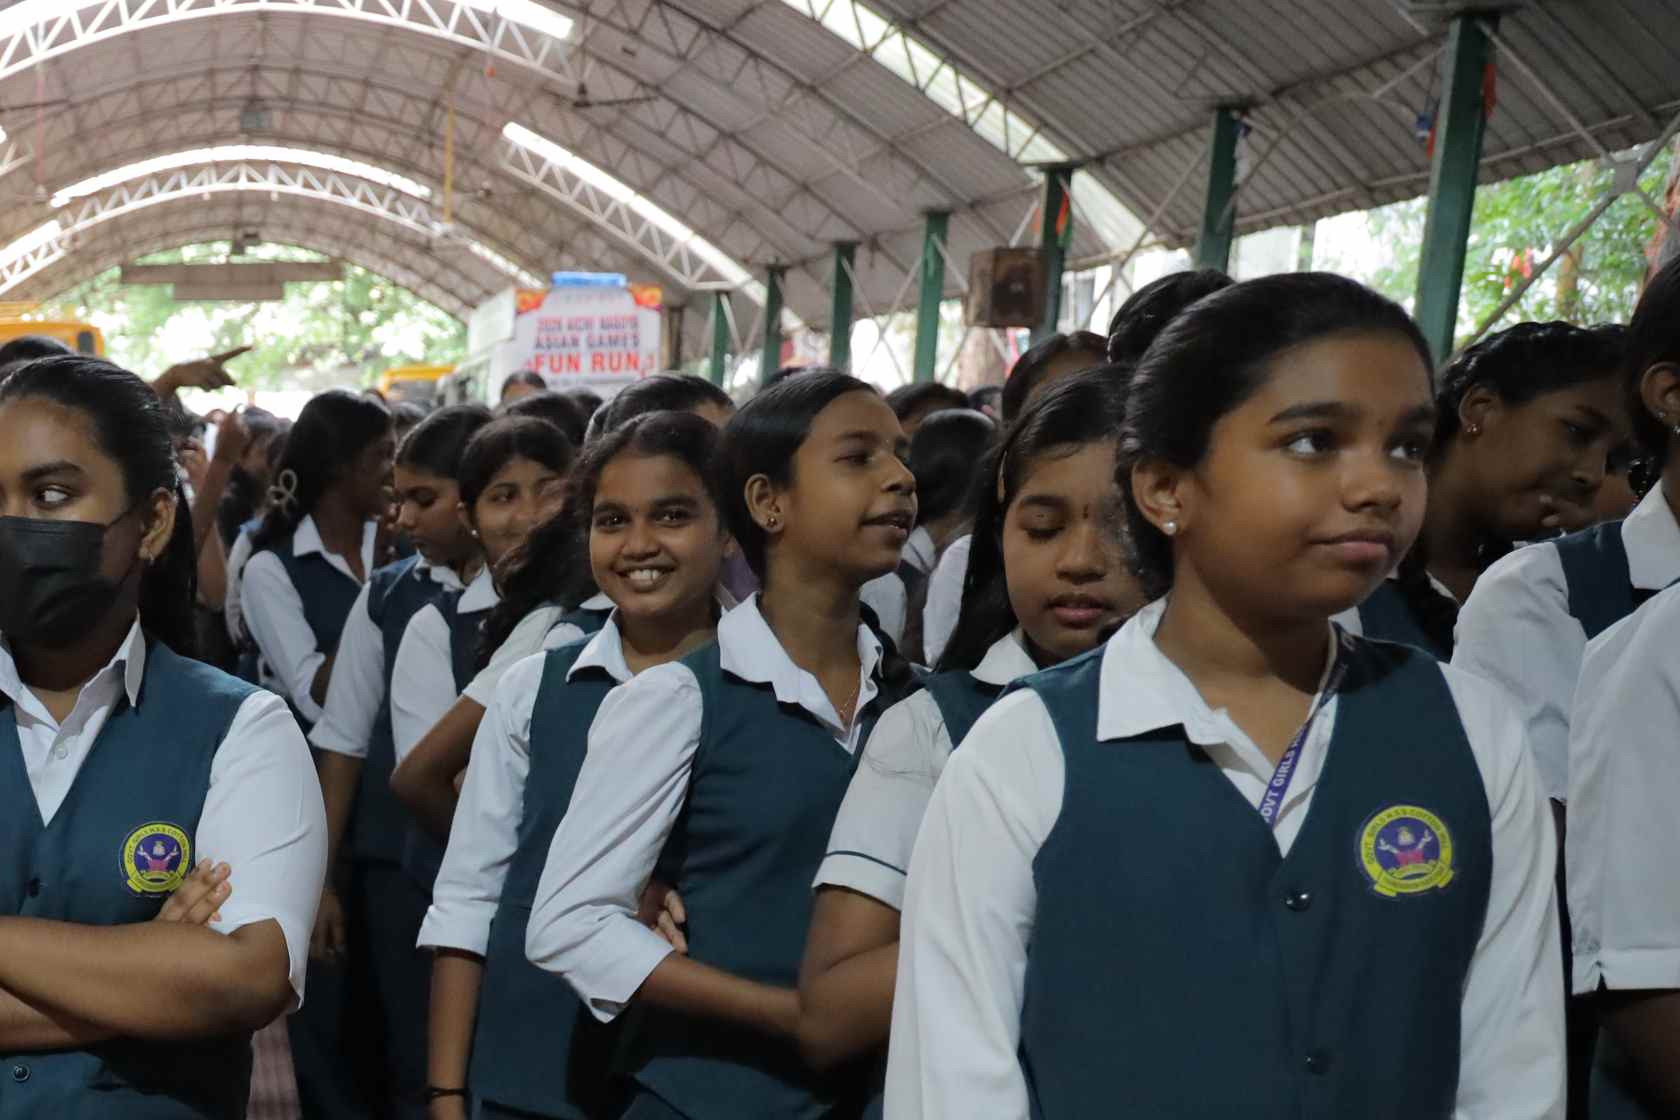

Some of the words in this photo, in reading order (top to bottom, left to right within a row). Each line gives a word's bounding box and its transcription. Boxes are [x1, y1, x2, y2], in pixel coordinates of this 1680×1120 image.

[535, 334, 580, 349] ASIAN
[587, 332, 640, 348] GAMES
[535, 352, 580, 372] FUN
[591, 351, 639, 372] RUN
